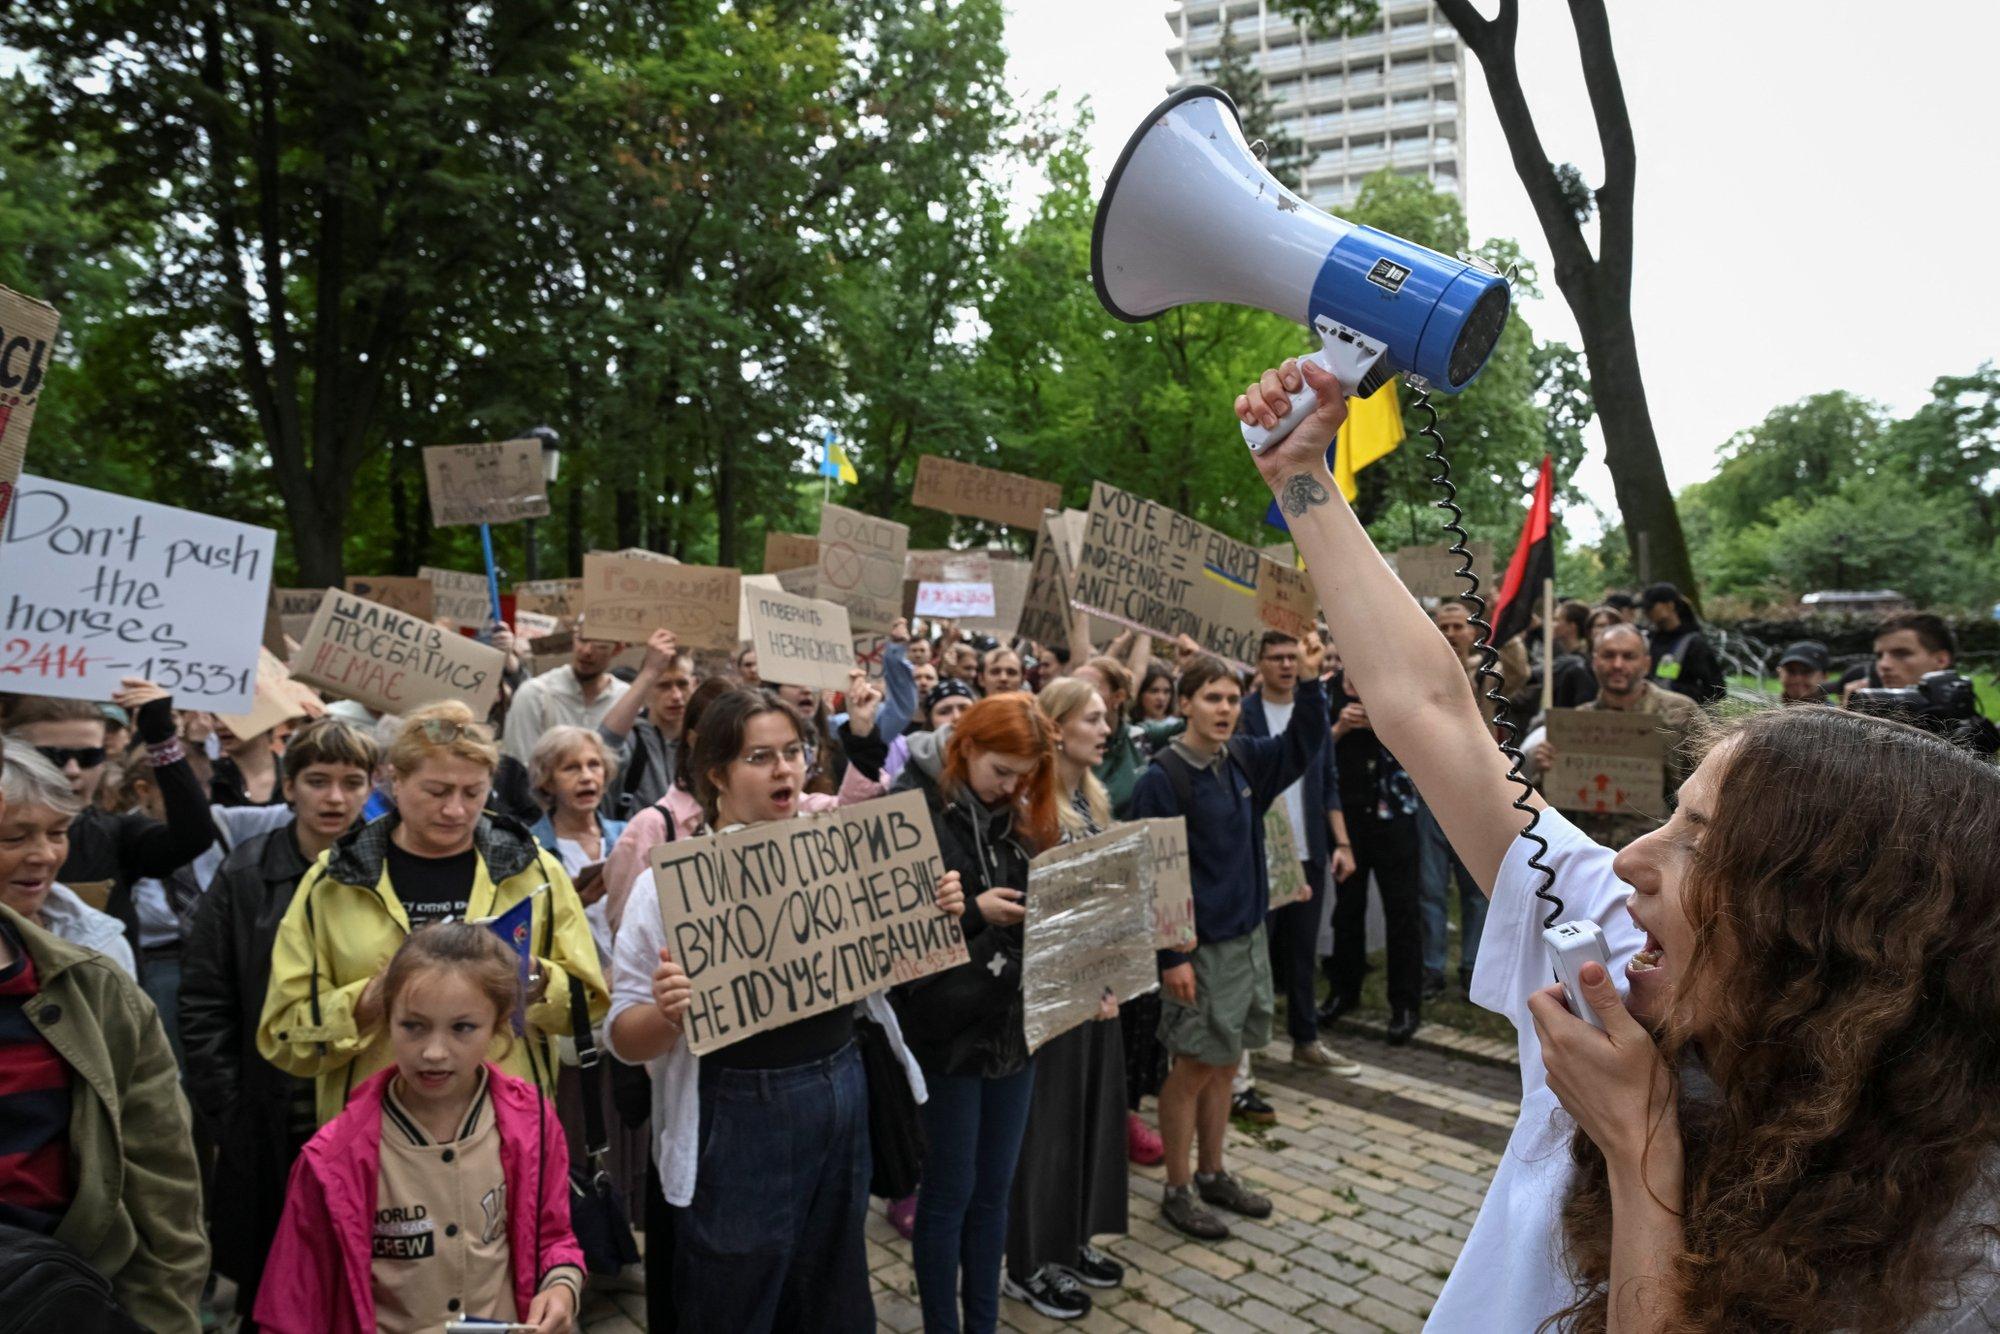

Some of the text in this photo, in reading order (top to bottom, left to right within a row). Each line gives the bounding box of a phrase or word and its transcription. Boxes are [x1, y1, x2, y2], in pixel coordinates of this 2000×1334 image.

[6, 487, 260, 582] Don't push
[1090, 511, 1170, 571] FUTURE
[1100, 486, 1160, 531] VOTE
[1168, 512, 1203, 552] FOR
[80, 565, 164, 611] the
[5, 594, 189, 652] horses
[309, 641, 406, 701] НЕМАЄ
[323, 615, 488, 694] ПРОЄБАТИСЯ
[661, 810, 922, 914] ТОЙ ХТО СТВОРИВ
[688, 985, 730, 1043] НЕ
[374, 1235, 427, 1257] CREW
